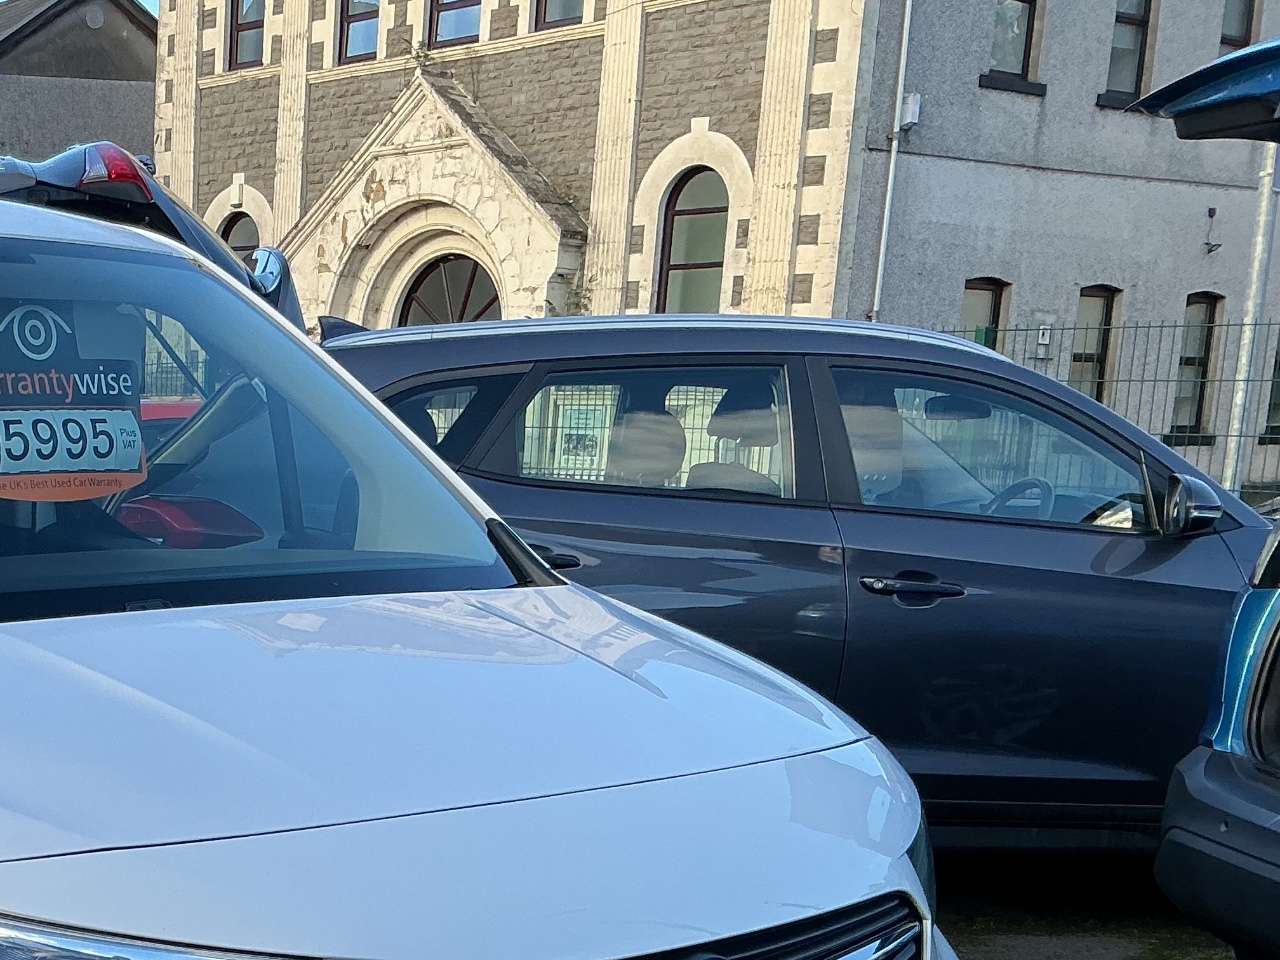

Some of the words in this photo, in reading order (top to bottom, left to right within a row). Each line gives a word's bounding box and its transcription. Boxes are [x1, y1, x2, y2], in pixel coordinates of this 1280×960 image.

[119, 428, 137, 438] Plus
[122, 439, 137, 449] VAT
[30, 479, 49, 489] Best
[51, 477, 72, 488] Used
[73, 477, 87, 487] Car
[87, 477, 122, 489] Warranty
